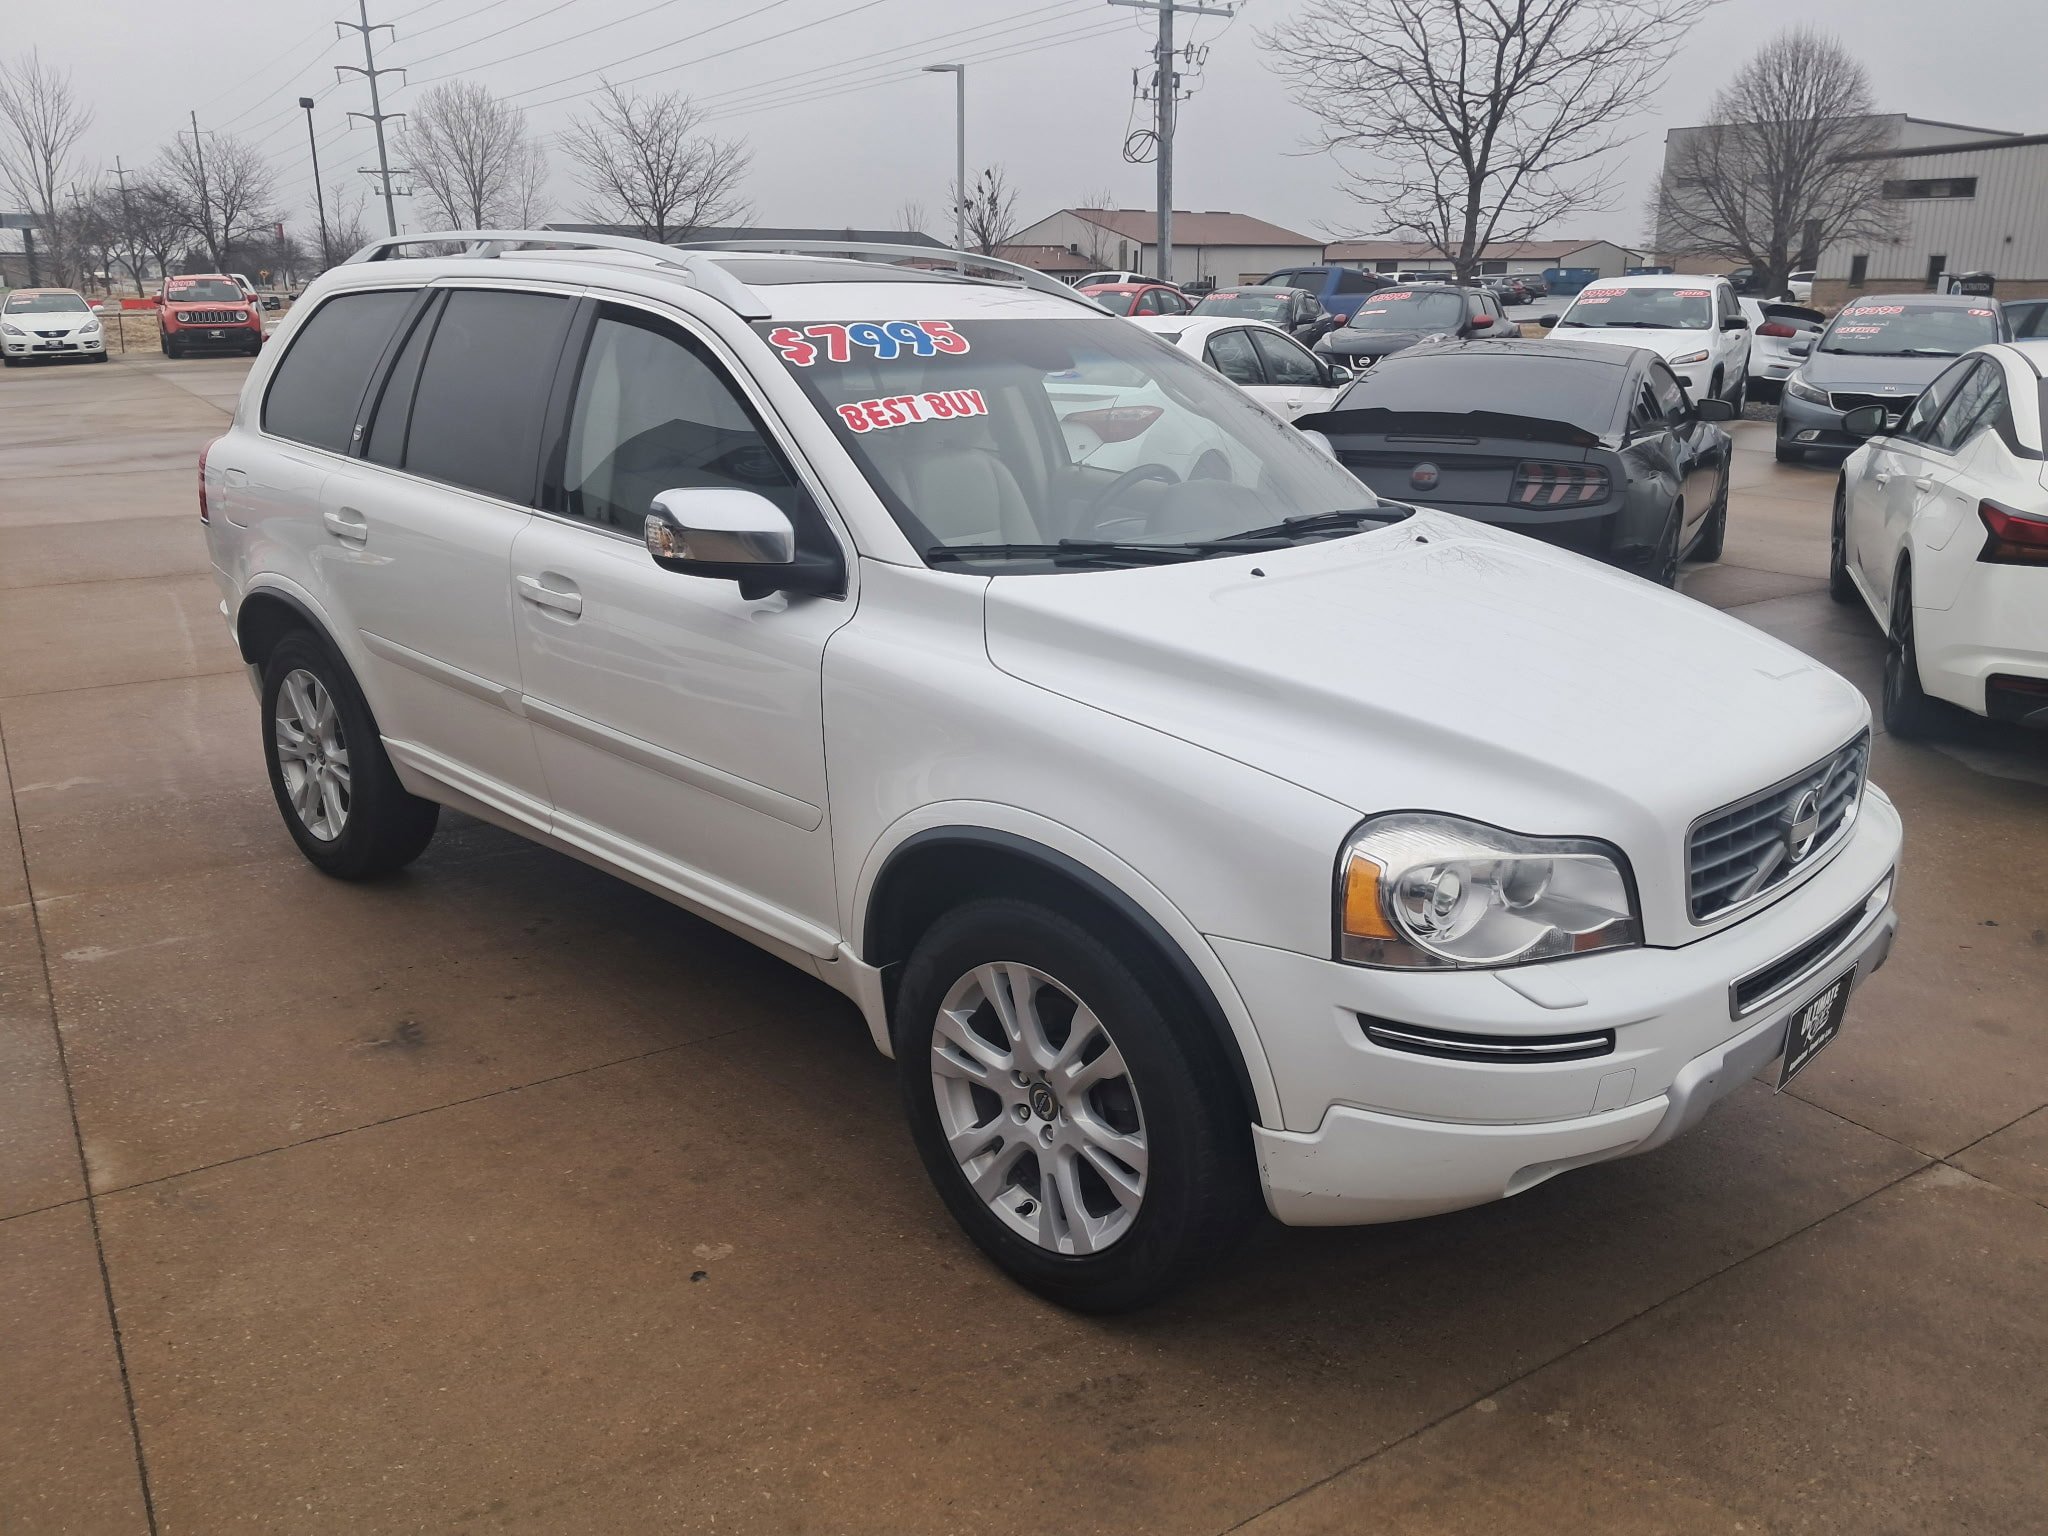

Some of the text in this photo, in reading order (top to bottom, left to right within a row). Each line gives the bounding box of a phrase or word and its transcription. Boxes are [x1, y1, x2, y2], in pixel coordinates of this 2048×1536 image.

[769, 321, 970, 366] $7995
[838, 389, 987, 432] BEST BUY
